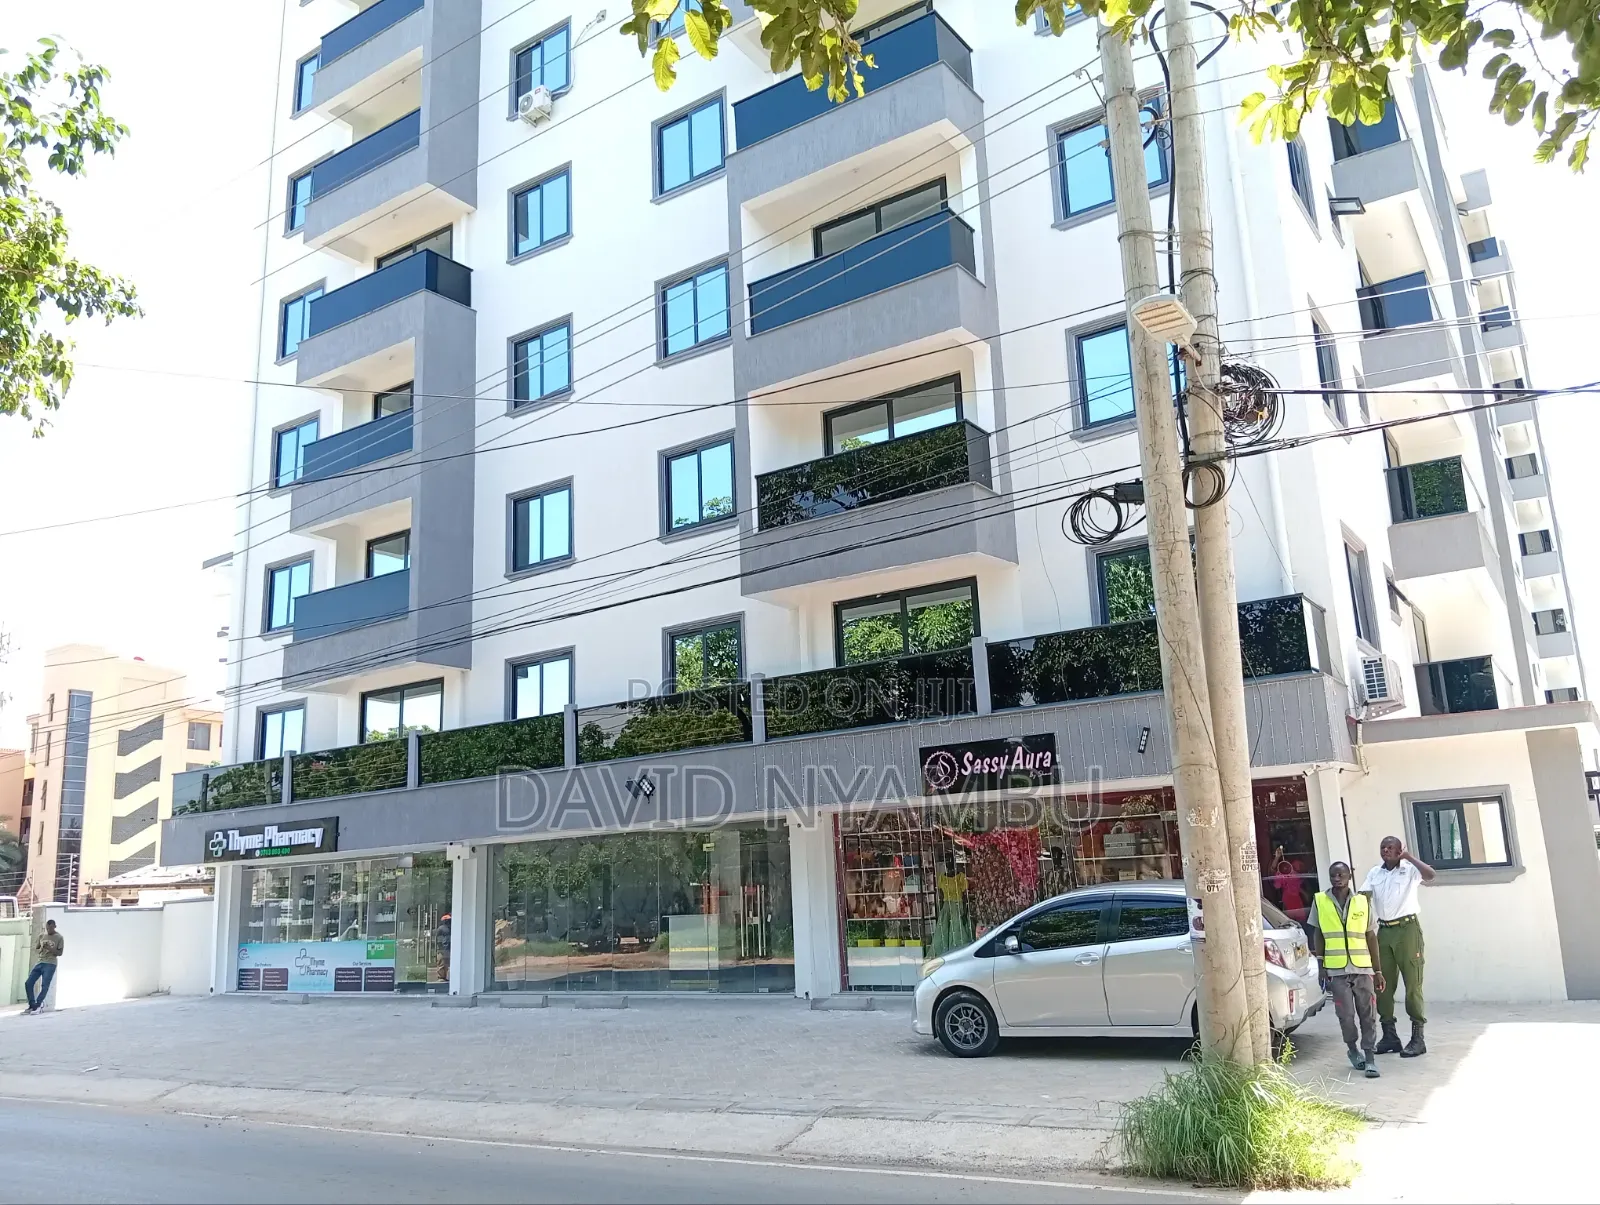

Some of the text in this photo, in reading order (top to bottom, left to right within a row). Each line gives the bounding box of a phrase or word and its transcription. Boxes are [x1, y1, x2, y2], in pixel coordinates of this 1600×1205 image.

[961, 746, 1052, 780] Sassy Aura
[228, 826, 324, 855] Thyme Pharmacy
[310, 957, 325, 967] Thyme
[306, 967, 329, 977] Pharmacy
